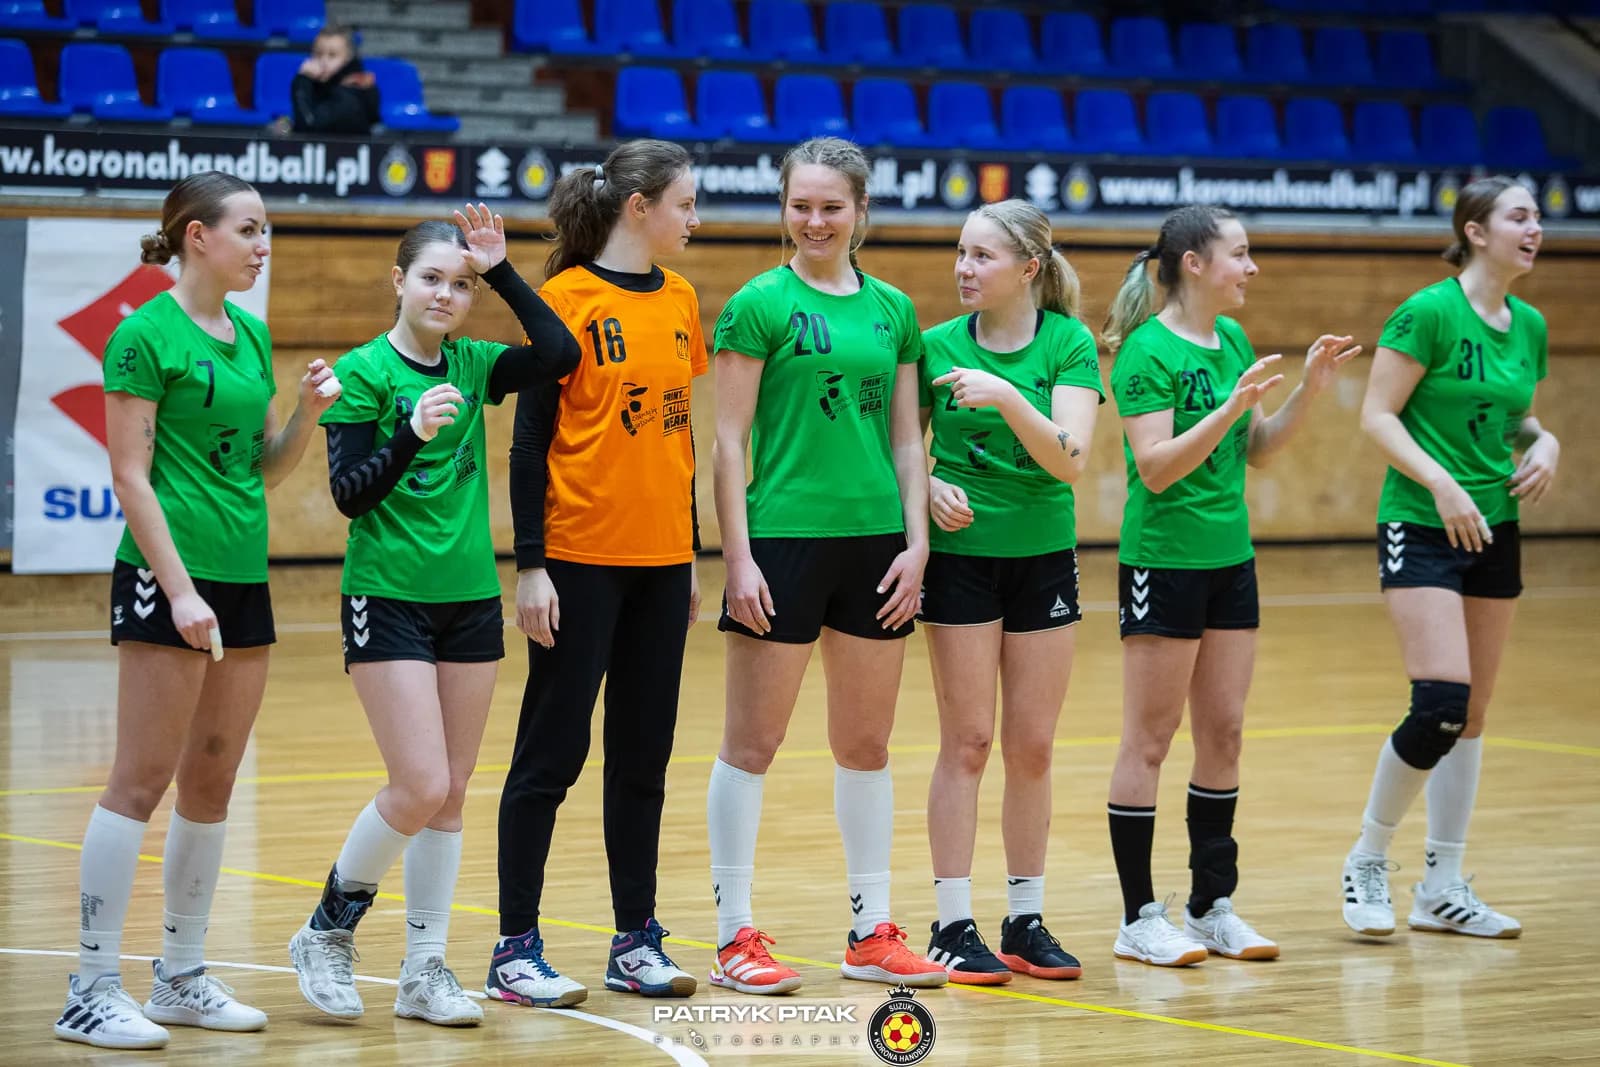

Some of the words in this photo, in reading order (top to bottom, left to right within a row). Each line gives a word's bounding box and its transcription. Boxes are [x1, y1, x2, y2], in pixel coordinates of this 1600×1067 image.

[586, 317, 627, 366] 16
[791, 312, 832, 356] 20
[1458, 338, 1485, 382] 31
[196, 360, 215, 408] 7
[1181, 368, 1216, 411] 29
[663, 413, 689, 431] WEAR
[860, 399, 884, 414] WEA
[44, 487, 125, 519] SU
